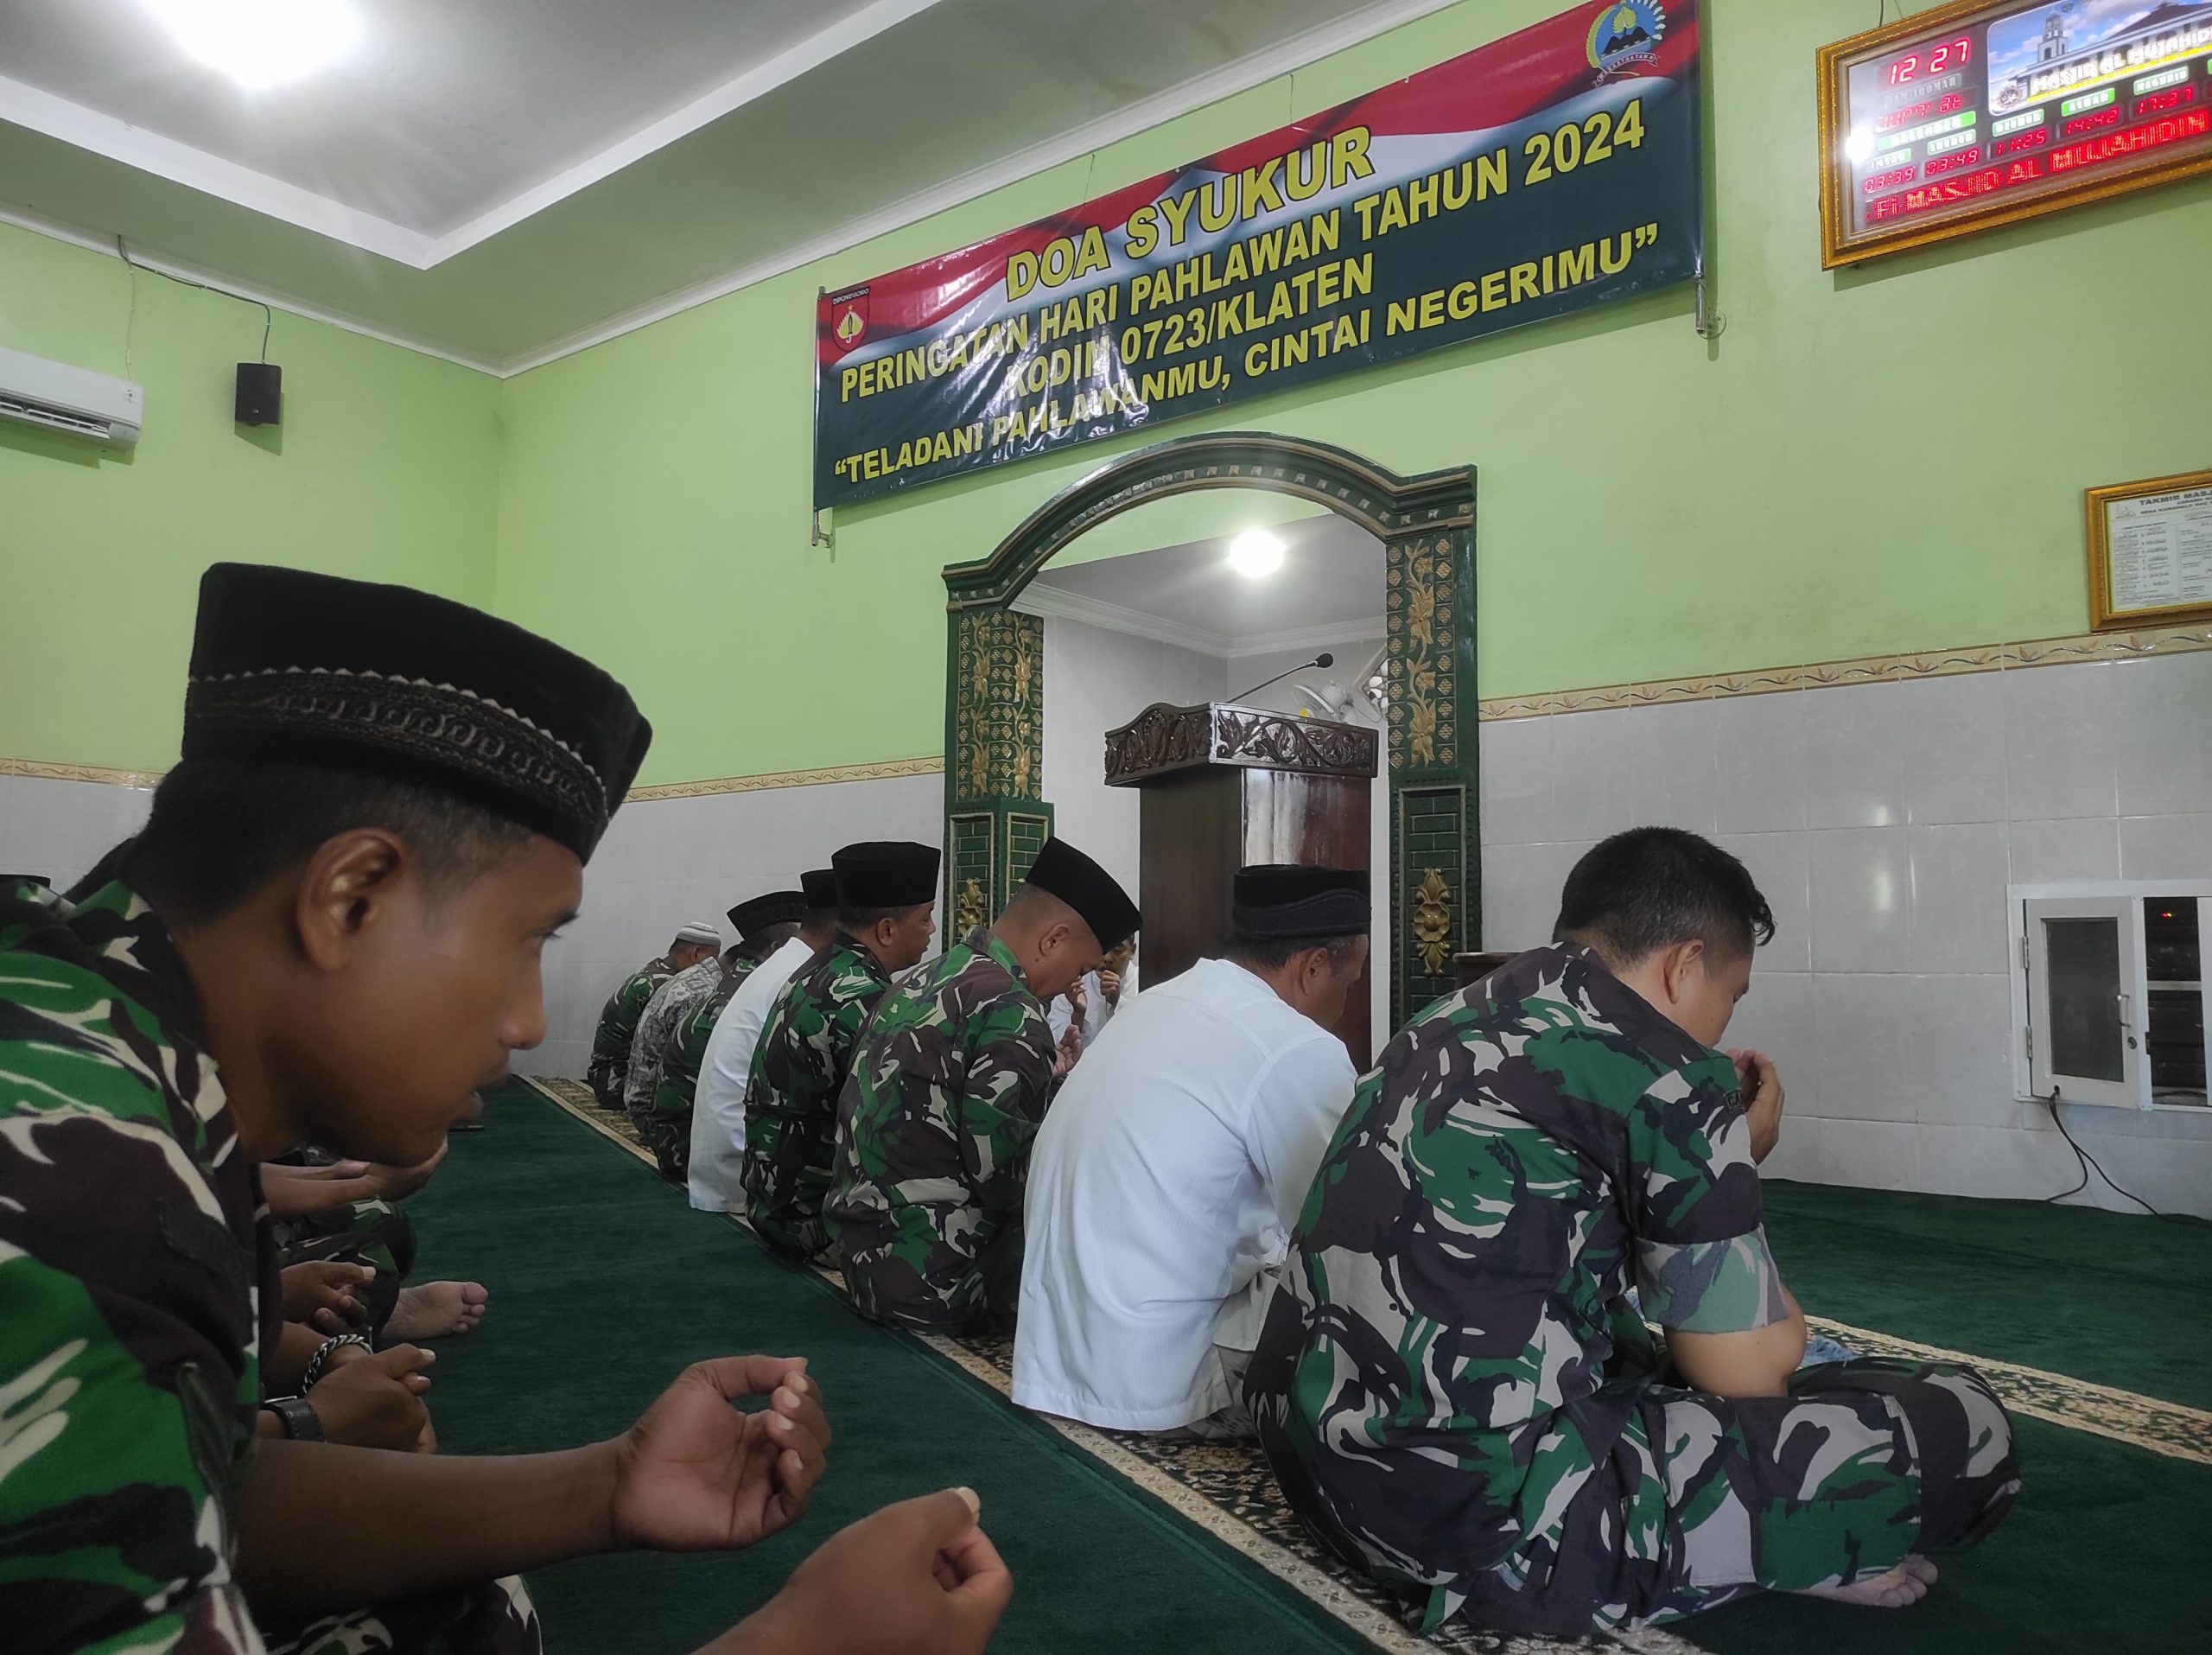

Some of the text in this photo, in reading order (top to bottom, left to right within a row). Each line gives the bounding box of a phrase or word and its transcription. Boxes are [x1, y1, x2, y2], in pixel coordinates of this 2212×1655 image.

[1005, 125, 1376, 302] DOA SYUKUR
[1864, 166, 1915, 193] 03:39
[1926, 149, 1979, 175] 03:49
[841, 99, 1645, 404] PERINGATAN HARI PAHLAWAN TAHUN 2024
[992, 355, 1231, 447] PAHLAWANMU,
[1244, 309, 1371, 377] CINTAI
[1006, 252, 1374, 402] KODIM 0723/KLATEN
[2139, 494, 2180, 506] TAKMIR
